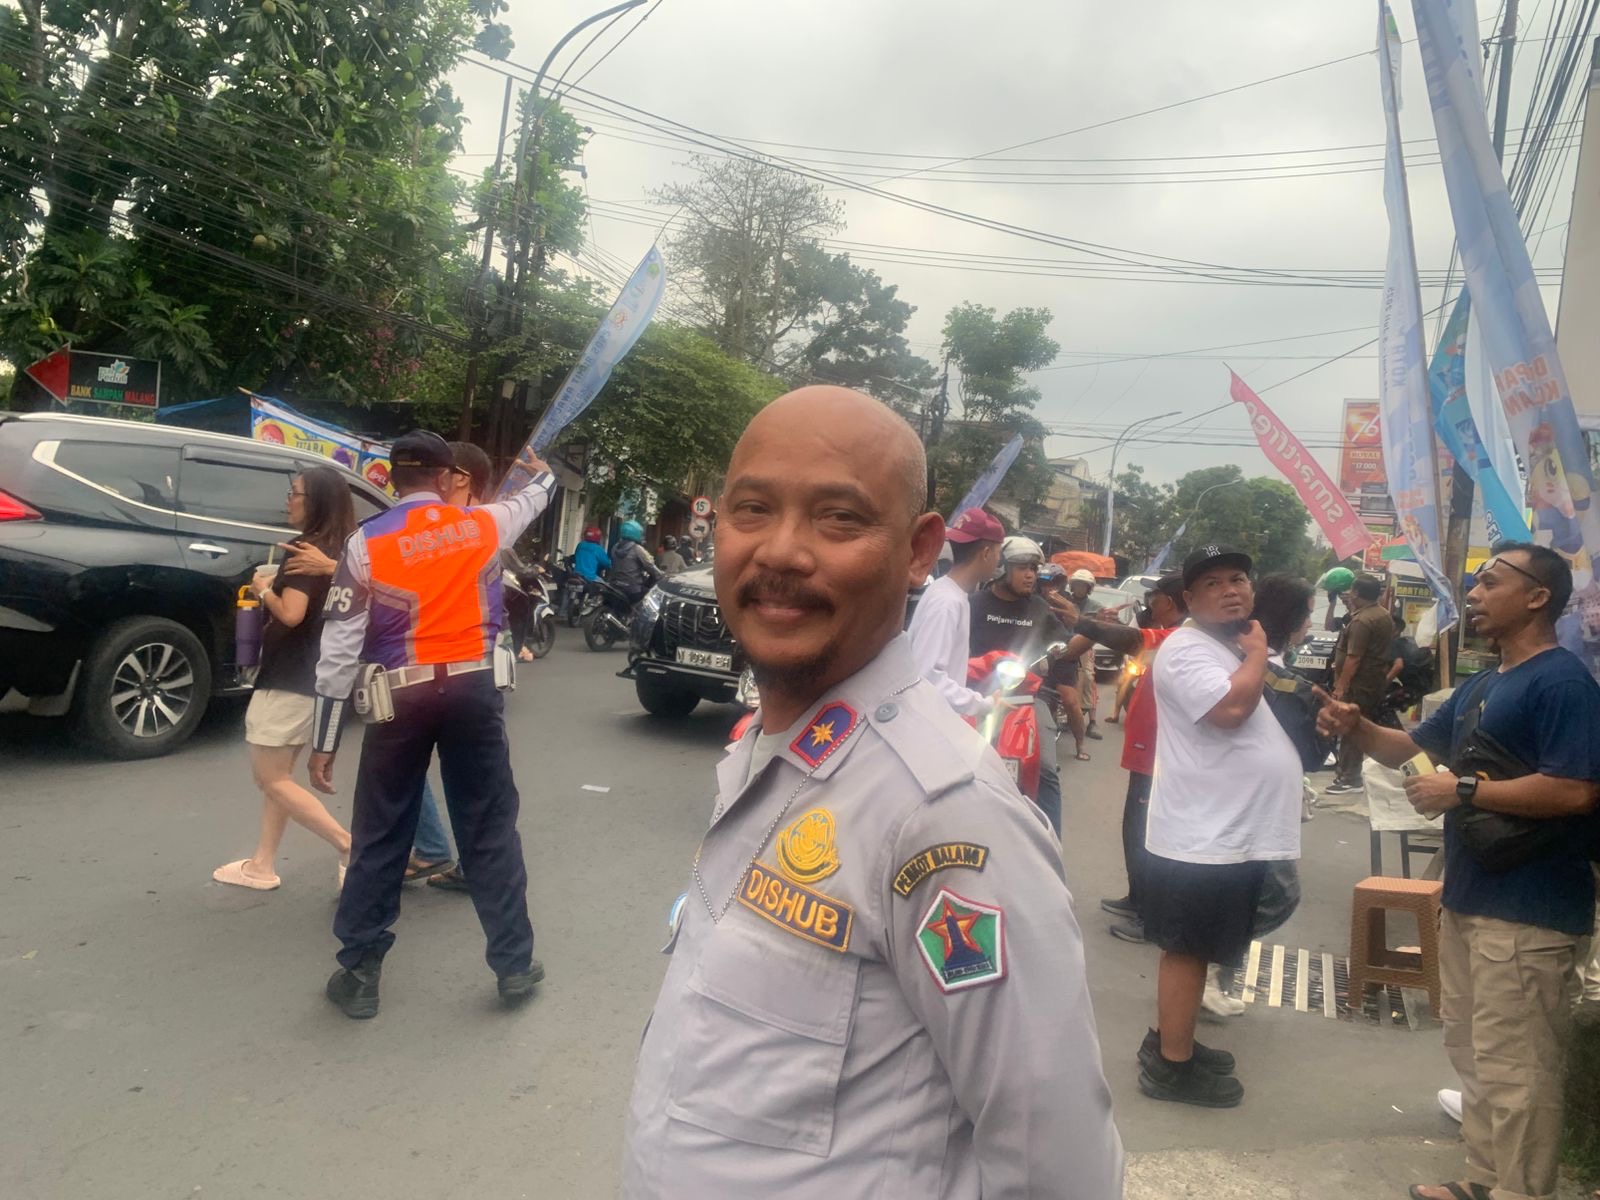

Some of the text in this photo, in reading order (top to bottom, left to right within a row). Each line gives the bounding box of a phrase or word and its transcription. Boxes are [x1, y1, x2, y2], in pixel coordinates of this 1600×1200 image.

[71, 385, 91, 397] BANK
[124, 391, 154, 404] MALANG
[399, 520, 480, 559] DISHUB
[897, 847, 980, 891] PEMKOT MALANG
[746, 869, 839, 939] DISHUB
